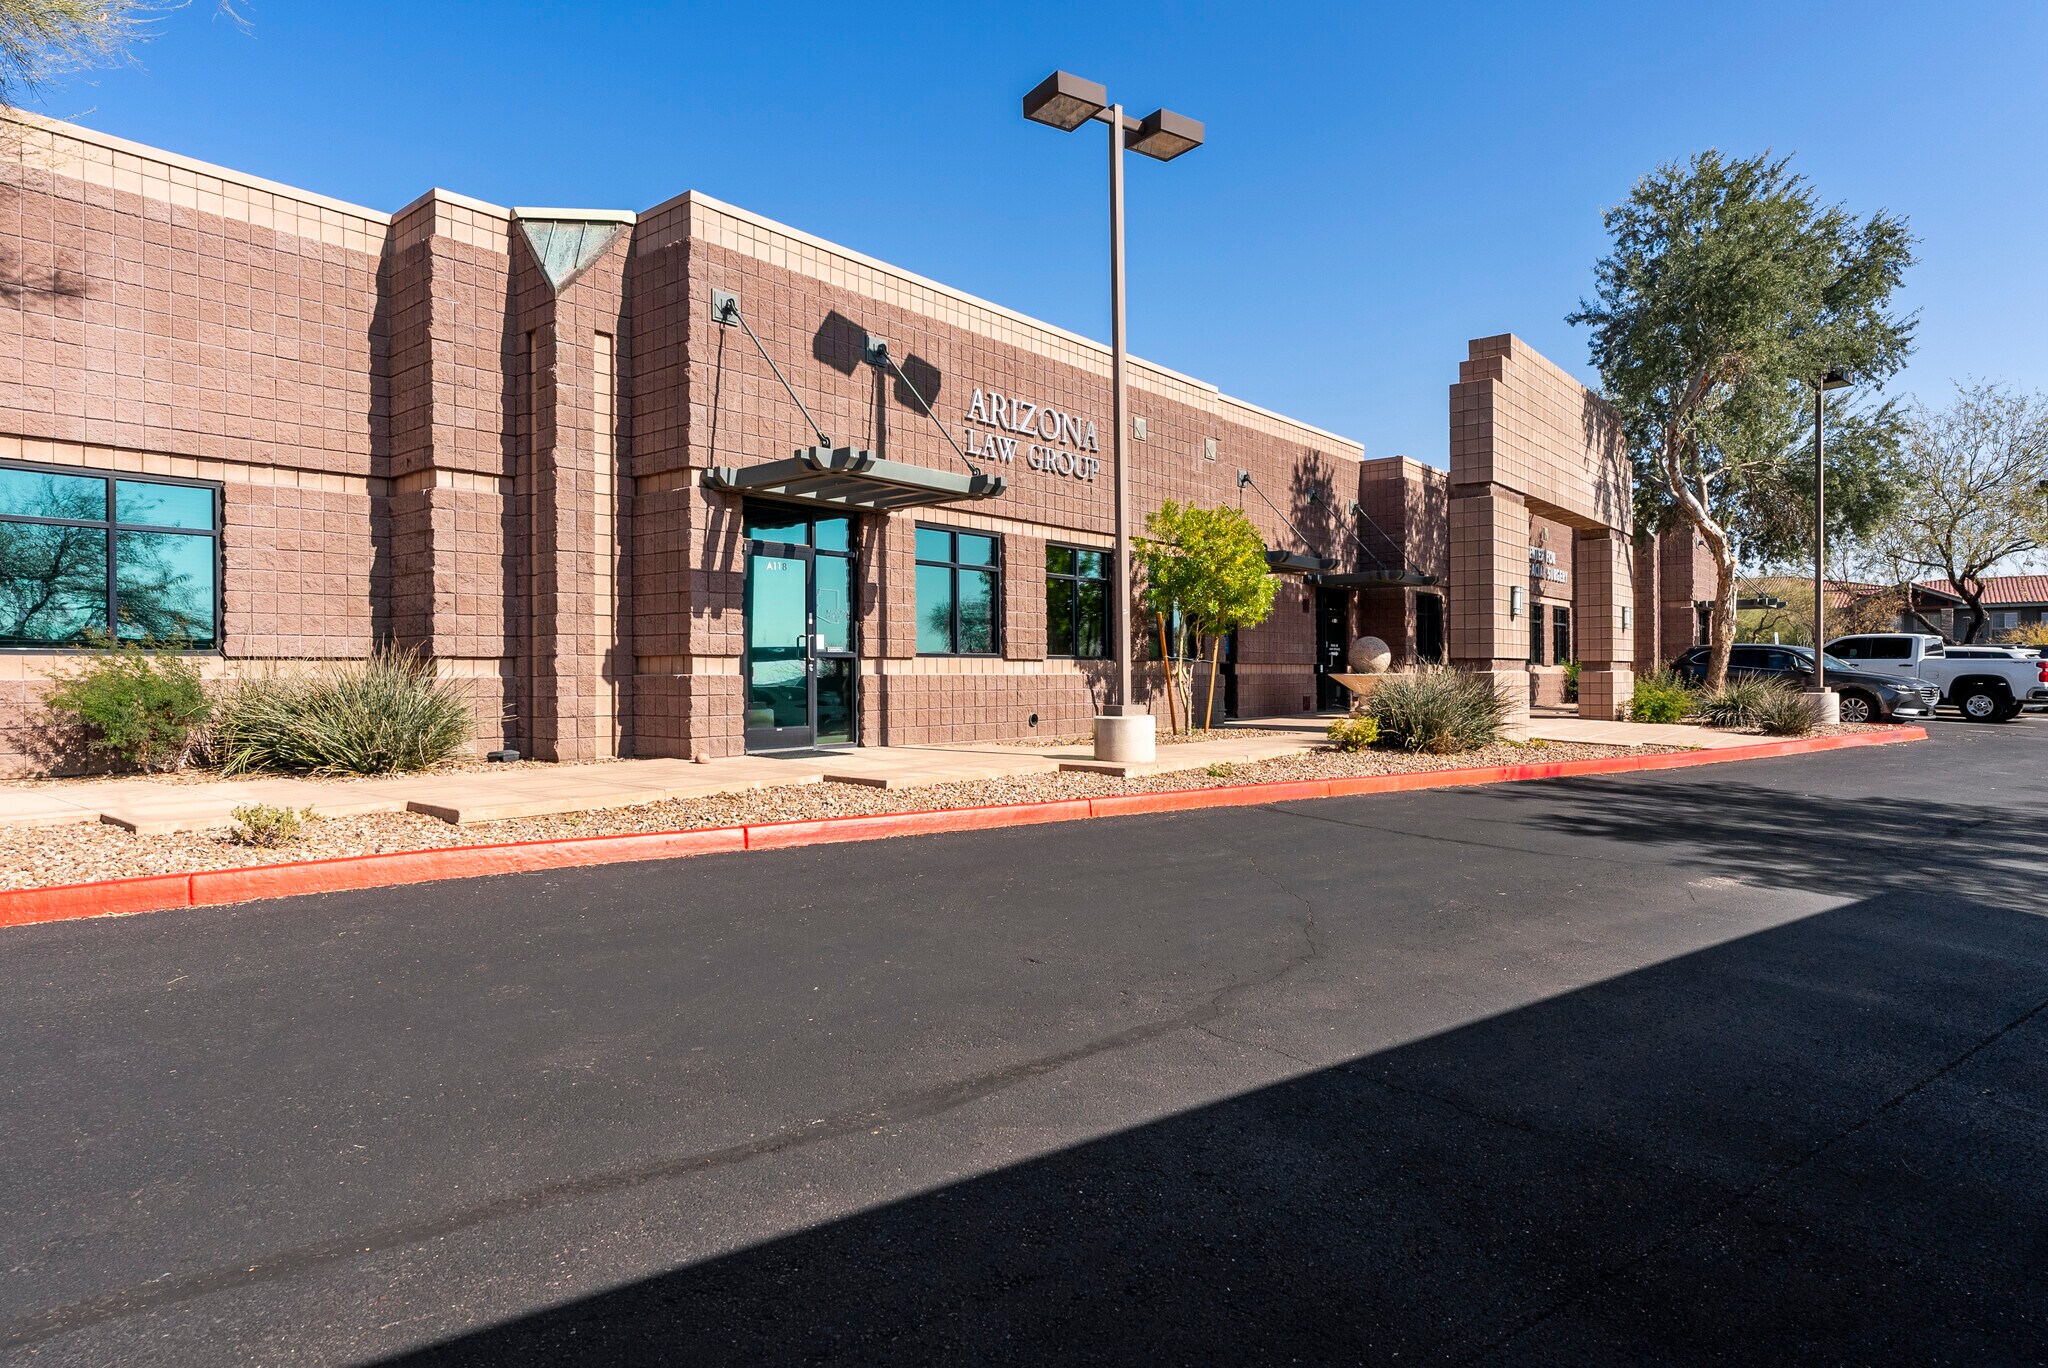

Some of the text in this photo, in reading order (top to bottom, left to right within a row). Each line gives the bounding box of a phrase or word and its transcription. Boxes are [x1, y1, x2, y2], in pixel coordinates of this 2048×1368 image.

[965, 387, 1100, 452] ARIZONA
[965, 429, 1100, 481] LAW GROUP
[766, 561, 787, 571] A118
[1529, 546, 1545, 561] ENTER
